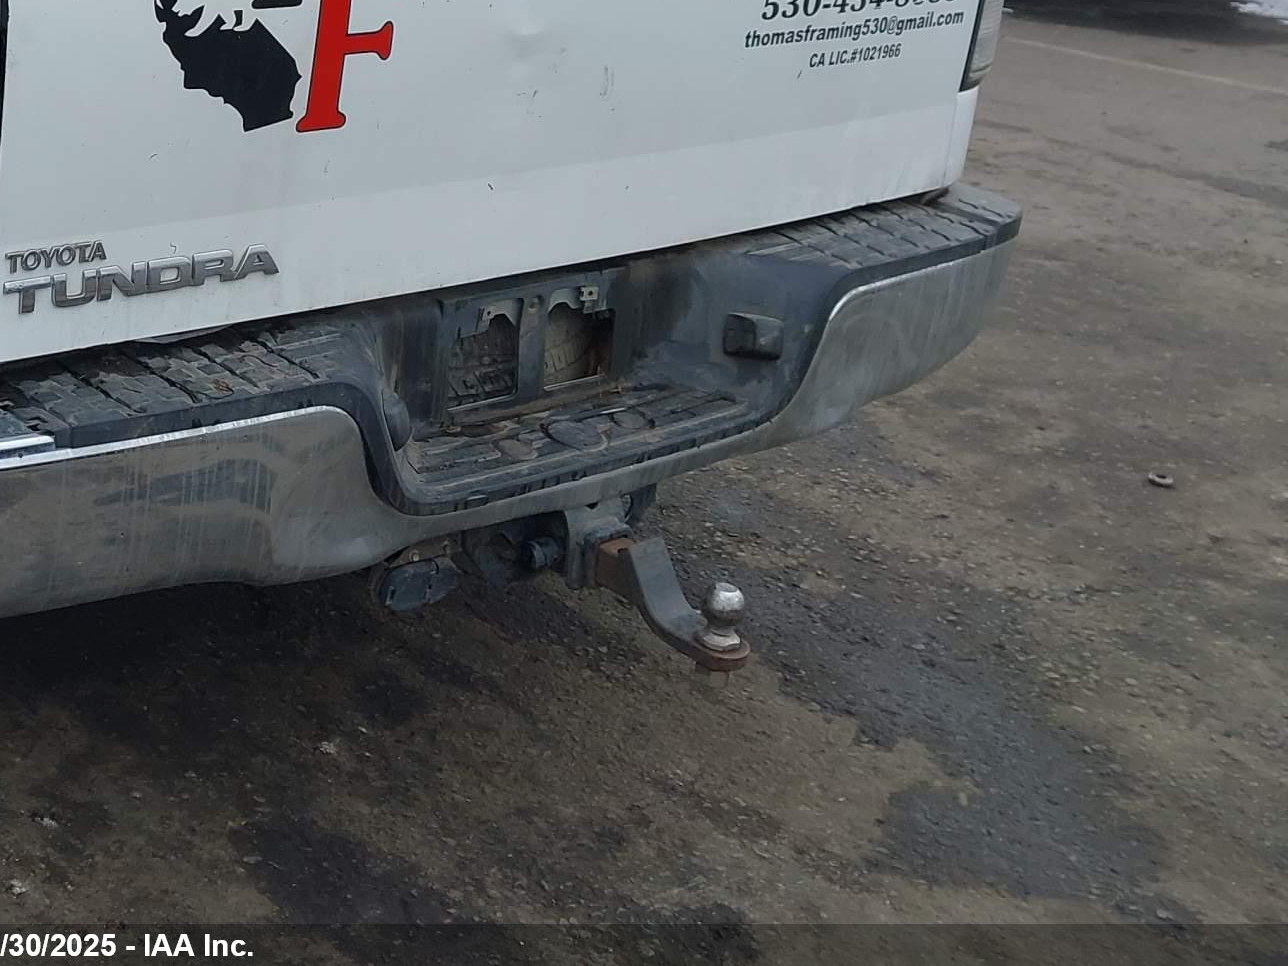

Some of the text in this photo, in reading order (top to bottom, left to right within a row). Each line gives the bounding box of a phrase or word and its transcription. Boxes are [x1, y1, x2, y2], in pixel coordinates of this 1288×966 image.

[744, 9, 965, 49] thomasframing530@gmail.com
[809, 52, 826, 68] CA
[5, 240, 107, 274] TOYOTA
[3, 242, 280, 315] TUNDRA
